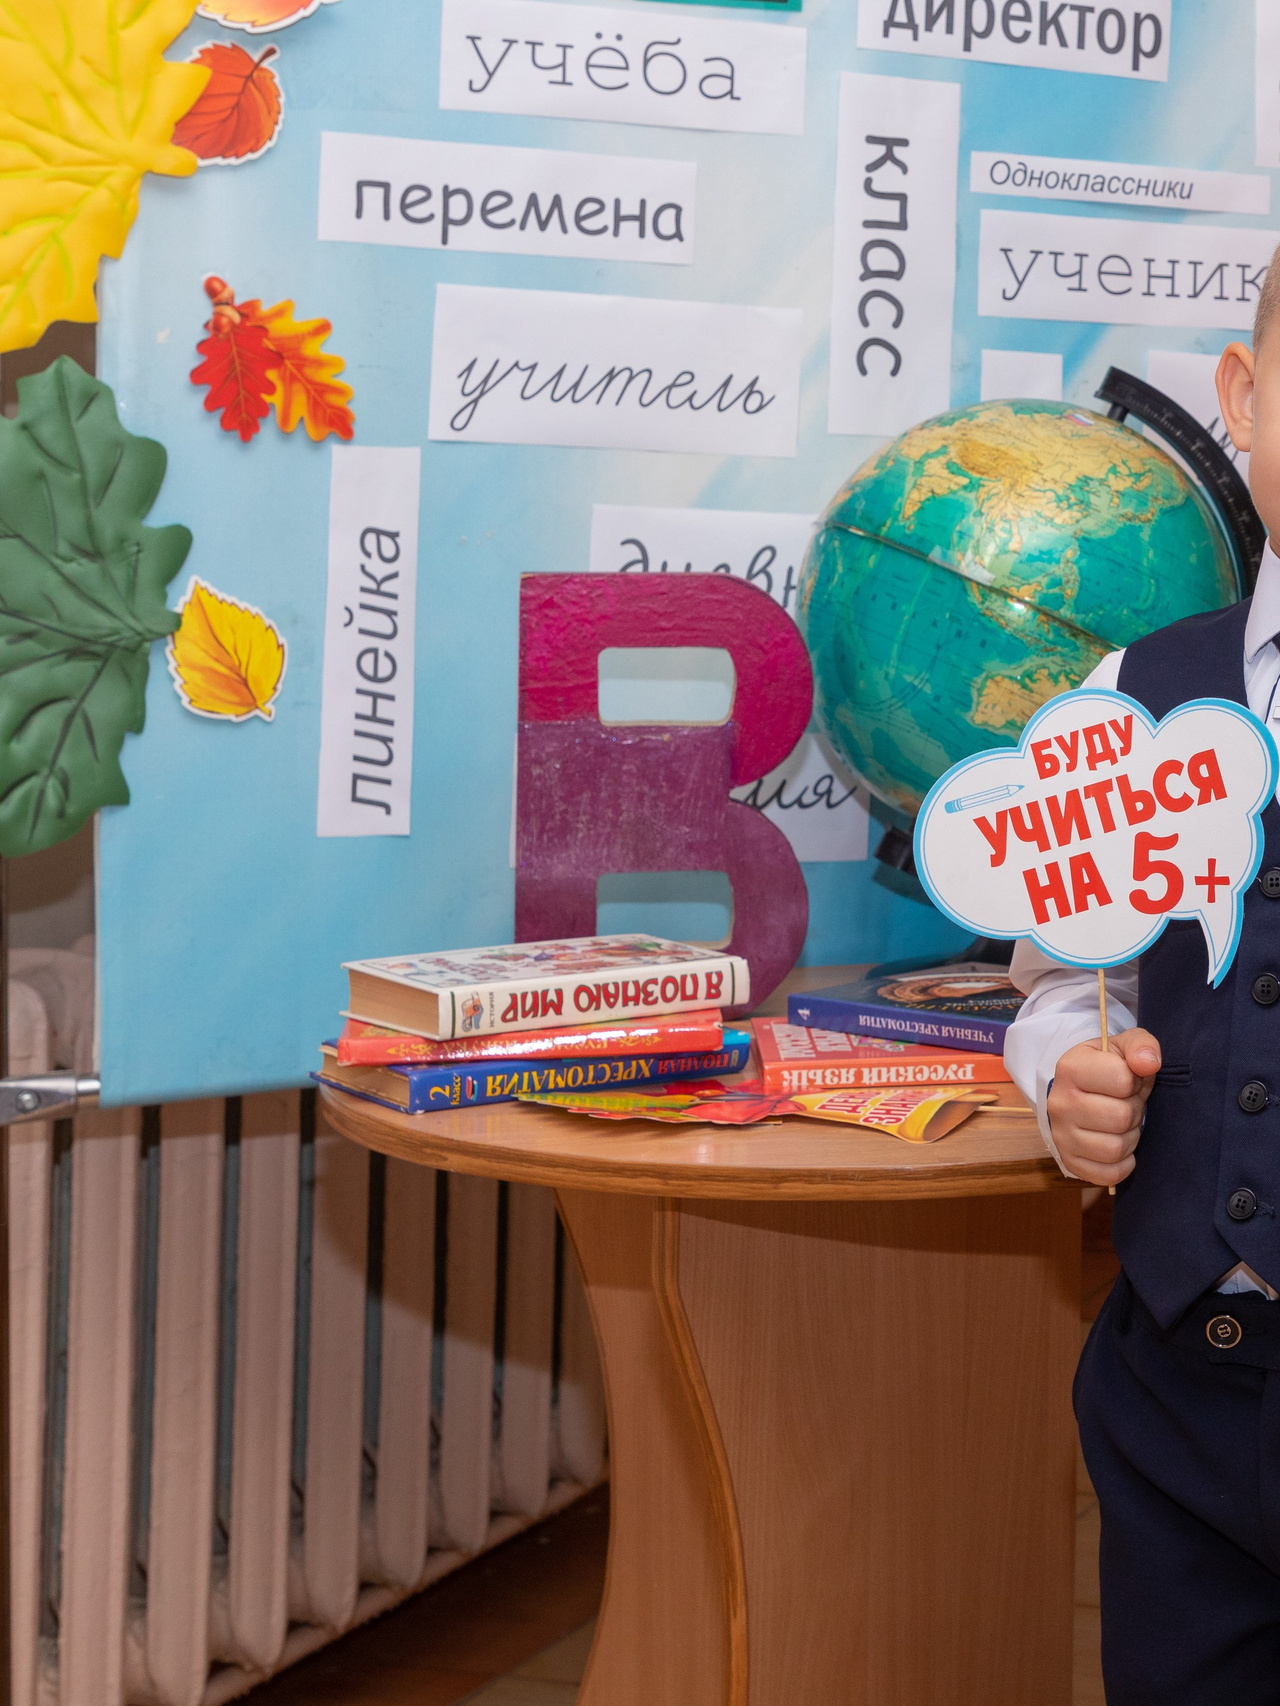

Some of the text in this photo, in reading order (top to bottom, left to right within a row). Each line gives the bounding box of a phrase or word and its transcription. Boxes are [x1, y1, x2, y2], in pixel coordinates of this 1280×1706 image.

[466, 32, 741, 100] учёба
[355, 179, 684, 245] перемена
[989, 159, 1194, 200] Одноклассники
[856, 134, 910, 377] класс
[1000, 248, 1269, 301] ученик
[450, 357, 776, 431] учитель
[343, 526, 401, 815] линейка
[1030, 714, 1133, 780] БУДУ
[972, 748, 1228, 868] УЧИТЬСЯ
[1022, 851, 1113, 925] НА
[501, 971, 723, 1023] Я ПОЗНАЮ МИР
[859, 1014, 995, 1044] УЧЕБНАЯ ХРЕСТОМАТИЯ
[429, 1084, 450, 1101] 2
[486, 1052, 729, 1097] ПОЛНАЯ ХРЕСТОМАТИЯ
[781, 1063, 975, 1087] РУССКИЙ ЯЗЫК
